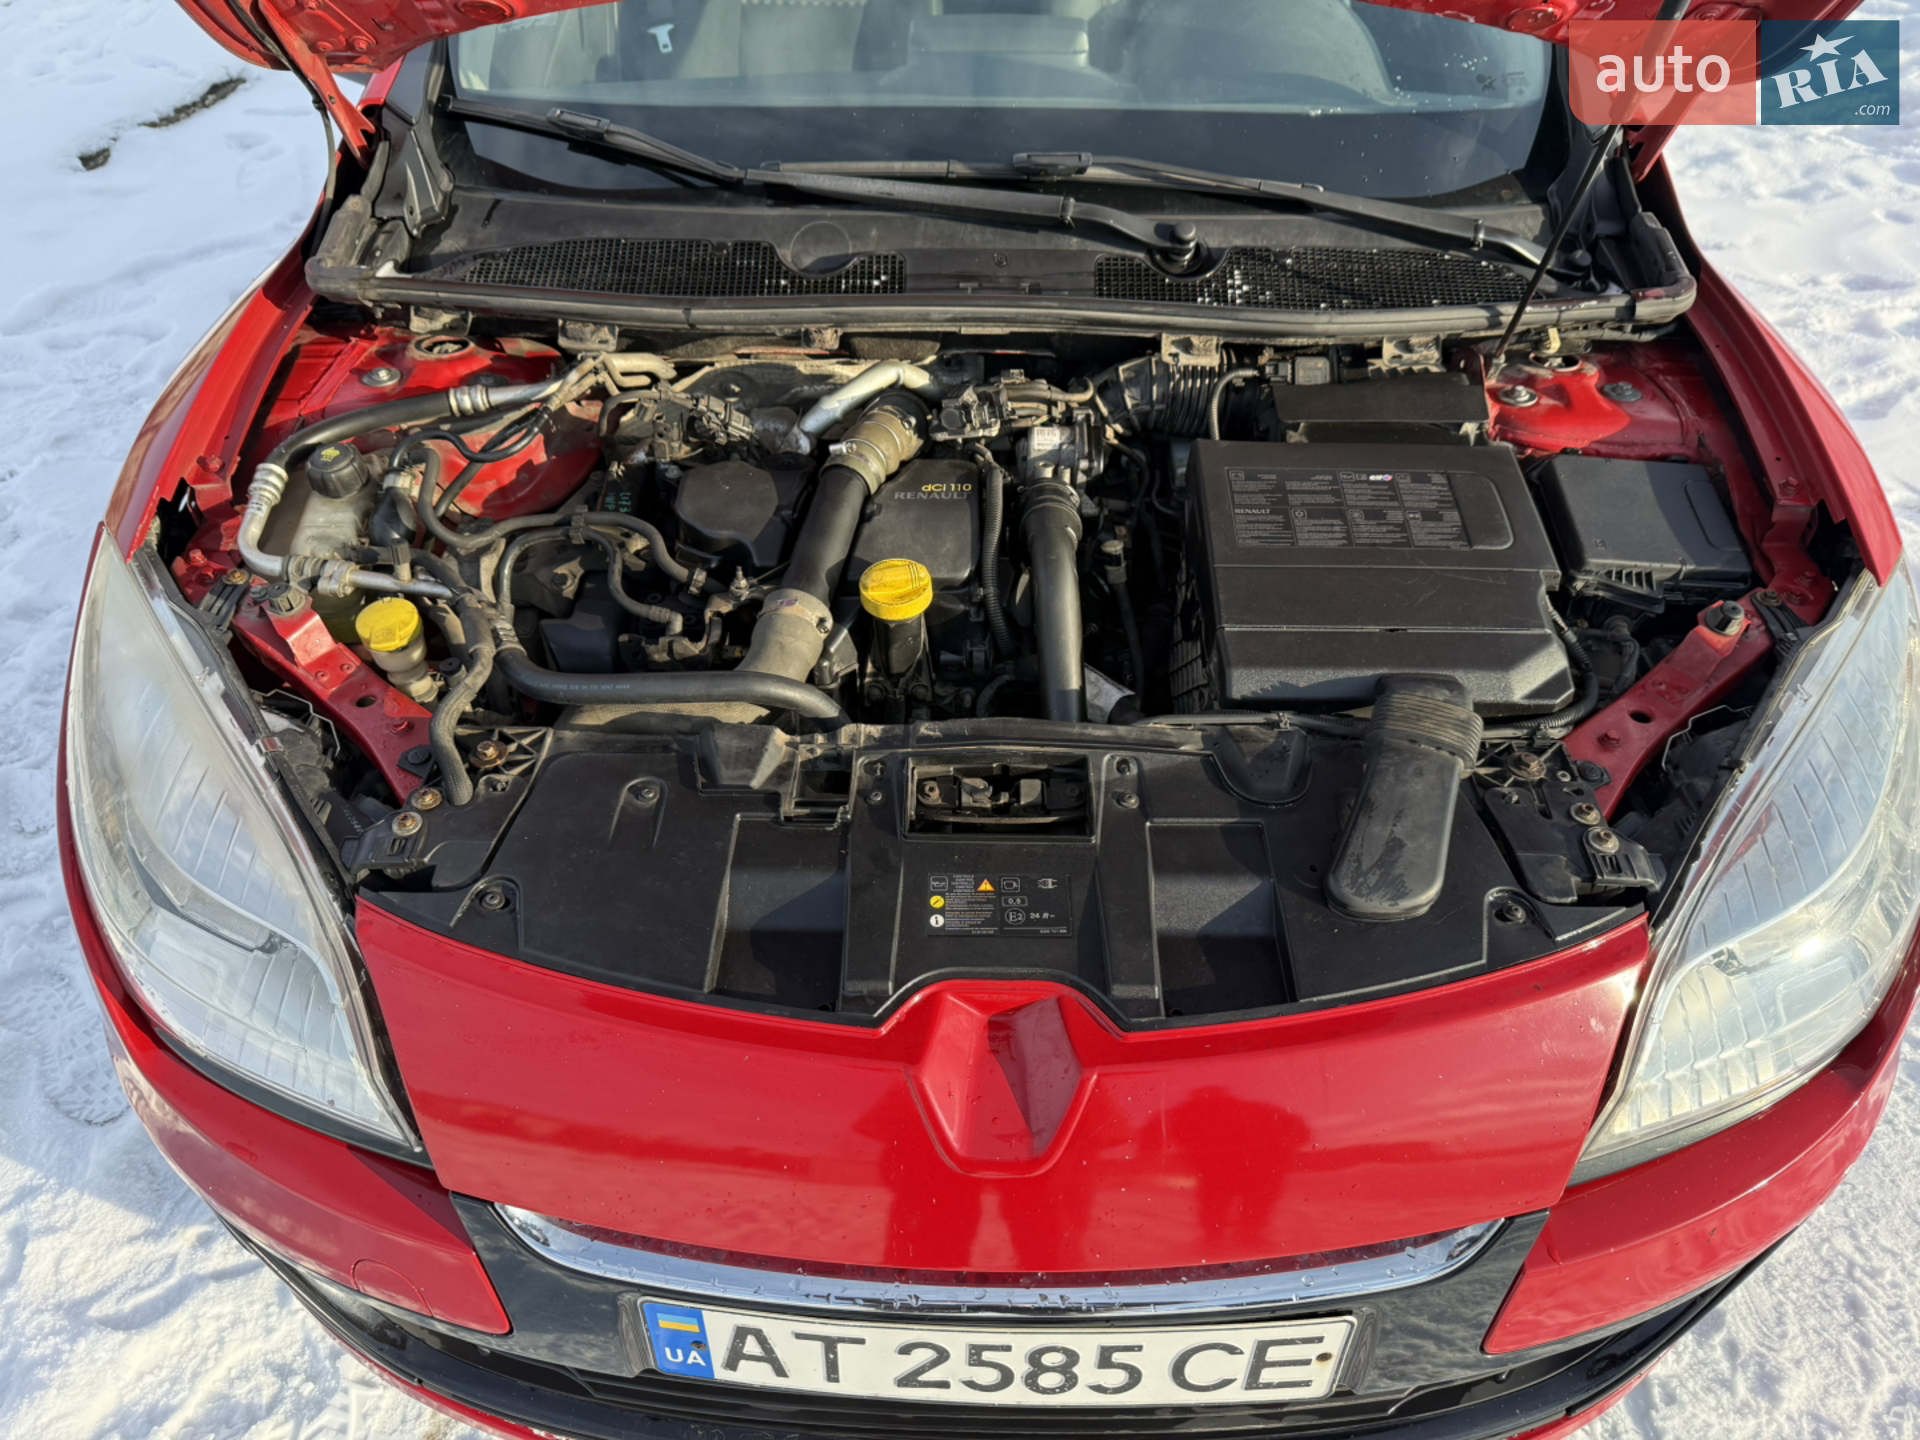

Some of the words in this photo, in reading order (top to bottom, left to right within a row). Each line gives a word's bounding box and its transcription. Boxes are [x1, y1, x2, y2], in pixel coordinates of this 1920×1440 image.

[950, 483, 972, 492] 110
[894, 491, 971, 500] RENAULT
[1234, 508, 1271, 516] RENAULT
[664, 1346, 707, 1367] UA
[720, 1324, 867, 1384] AT
[893, 1341, 1144, 1395] 2585
[1168, 1335, 1326, 1394] CE
